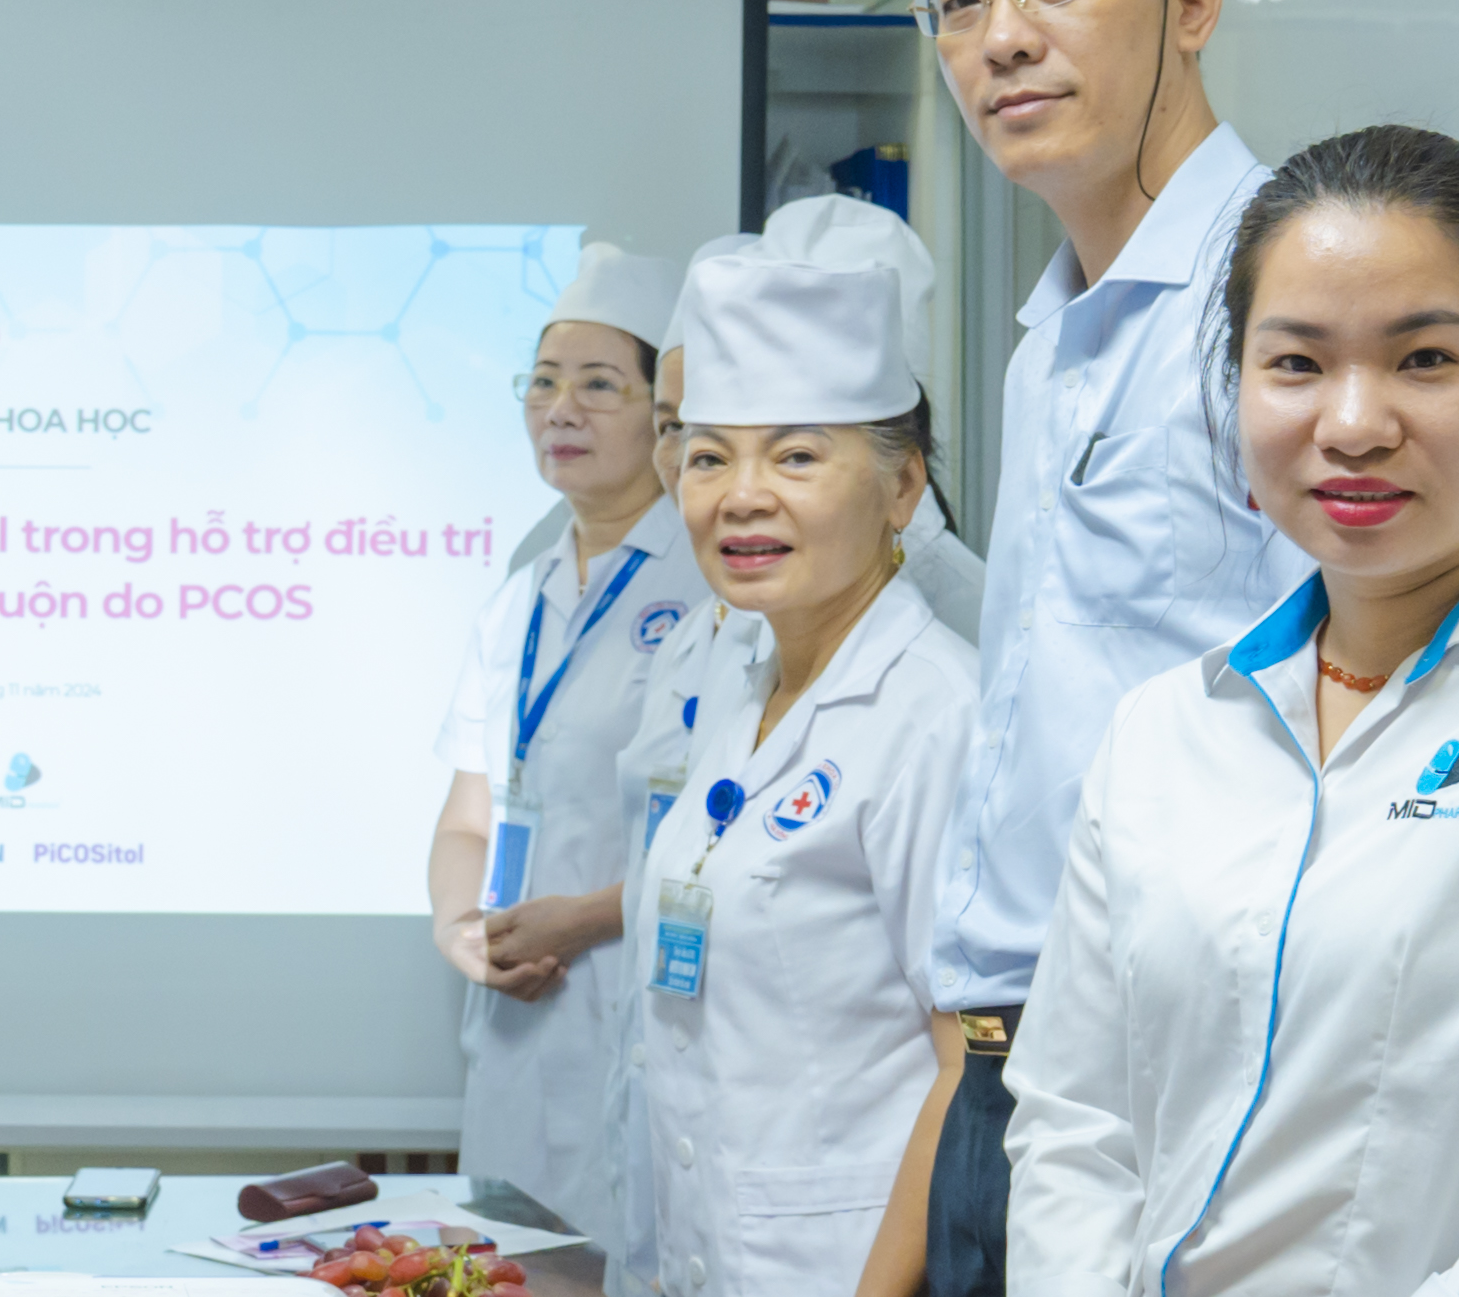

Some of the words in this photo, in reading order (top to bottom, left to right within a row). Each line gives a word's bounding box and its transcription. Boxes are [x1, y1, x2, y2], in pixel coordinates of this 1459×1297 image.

[76, 407, 152, 440] HỌC
[22, 517, 154, 564] trong
[169, 509, 230, 555] hỗ
[242, 519, 312, 565] trợ
[325, 514, 428, 558] điều
[441, 516, 493, 567] trị
[102, 582, 164, 620] do
[179, 583, 313, 622] PCOS
[34, 843, 145, 864] PiCOSitol
